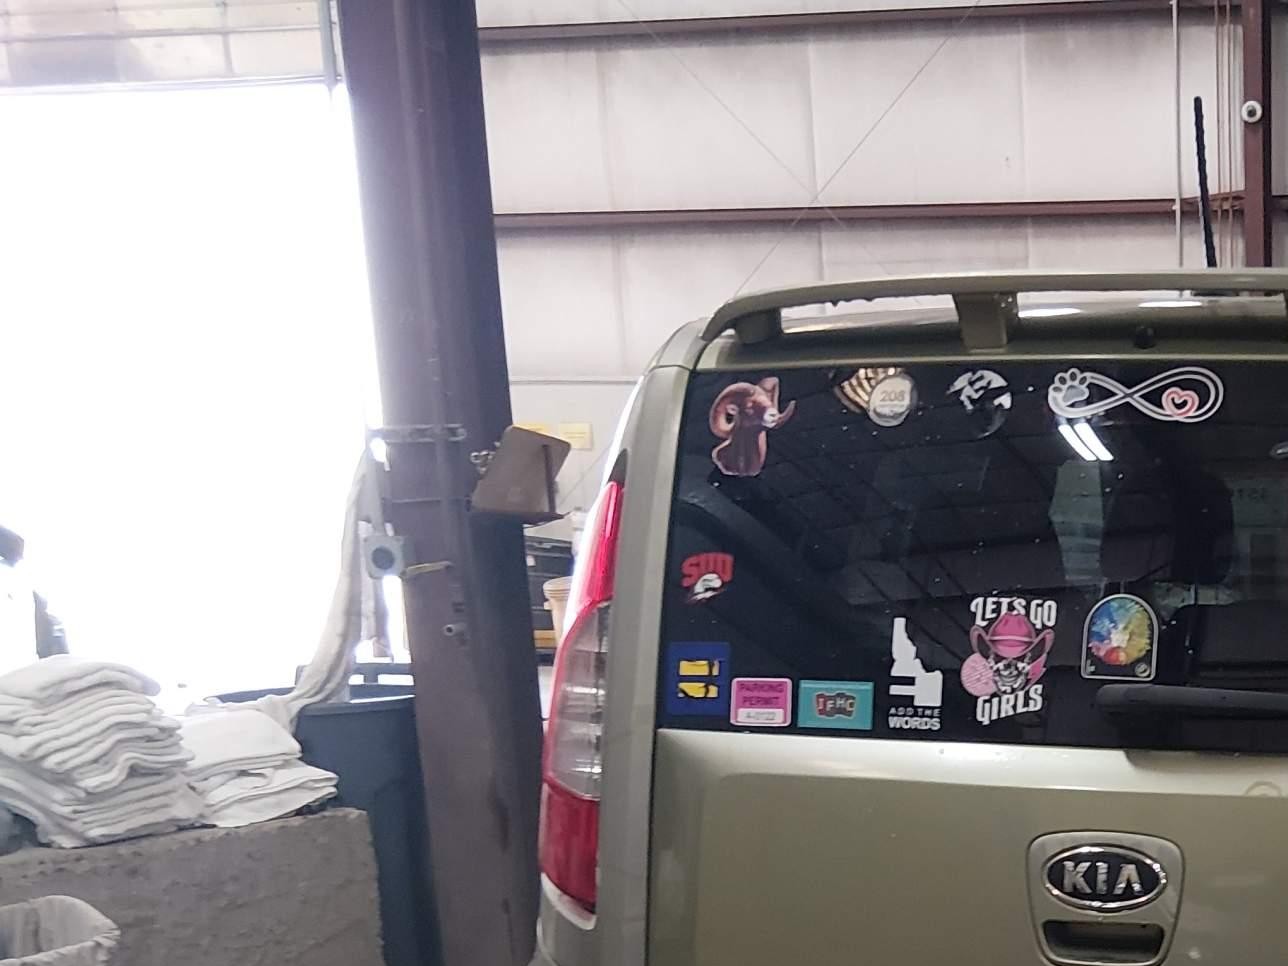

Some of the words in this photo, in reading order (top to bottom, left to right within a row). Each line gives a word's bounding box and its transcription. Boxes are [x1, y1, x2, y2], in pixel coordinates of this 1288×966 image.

[1029, 599, 1058, 630] GO
[889, 707, 915, 717] ADD
[918, 708, 942, 718] THE
[975, 684, 1044, 726] GIRLS
[888, 716, 942, 731] WORDS
[1062, 860, 1145, 896] KIA
